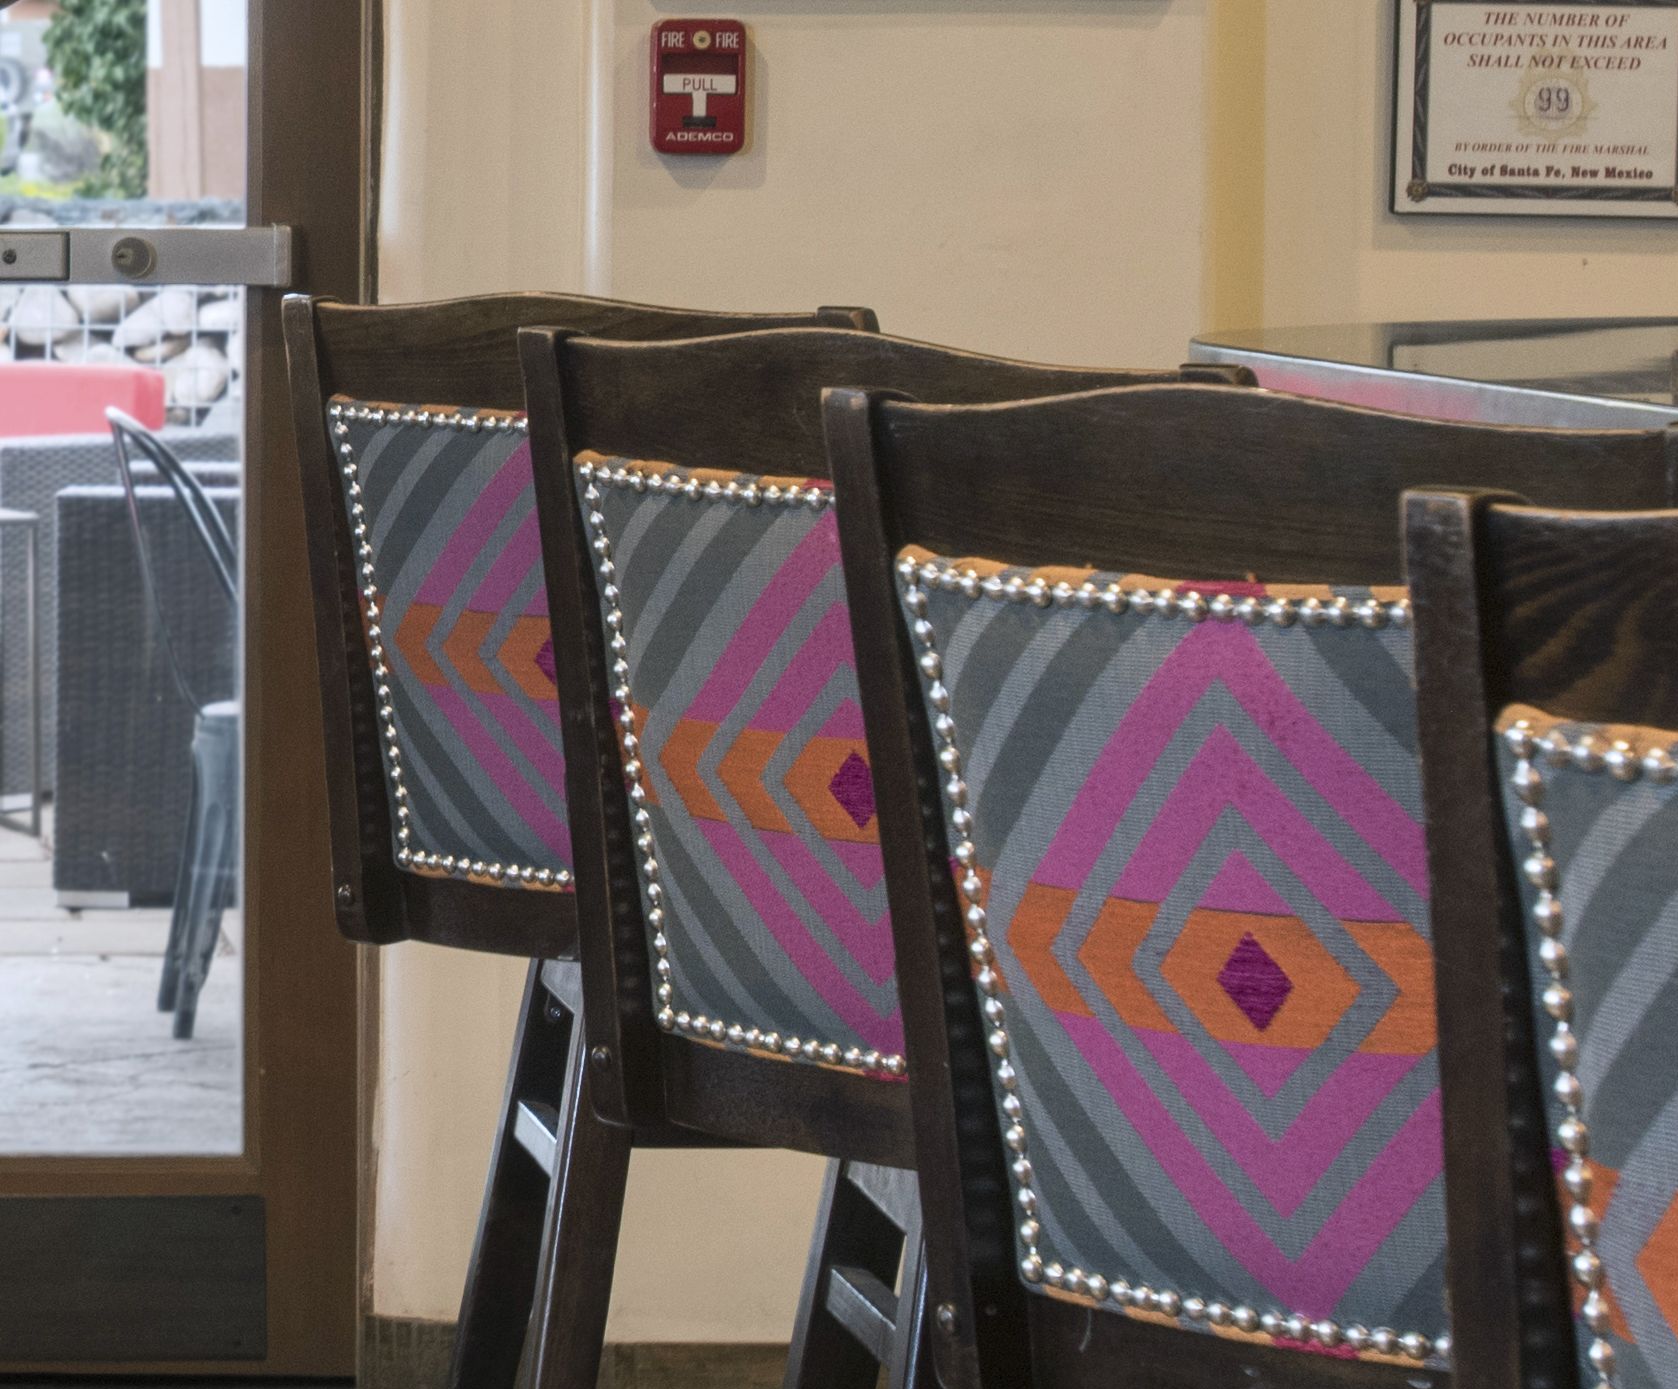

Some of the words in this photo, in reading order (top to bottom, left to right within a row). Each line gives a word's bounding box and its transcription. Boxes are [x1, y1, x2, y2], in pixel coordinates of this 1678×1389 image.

[1483, 12, 1517, 26] THE
[1523, 12, 1600, 27] NUMBER
[1604, 13, 1631, 28] OF
[661, 31, 685, 48] FIRE
[715, 31, 740, 49] FIRE
[1443, 32, 1547, 48] OCCUPANTS
[1552, 34, 1572, 48] IN
[1576, 35, 1617, 48] THIS
[1621, 37, 1667, 49] AREA
[1467, 54, 1524, 69] SHALL
[1529, 55, 1566, 70] NOT
[1570, 56, 1642, 71] EXCEED
[682, 77, 718, 92] PULL
[1537, 86, 1571, 112] 99
[665, 131, 734, 142] ADEMCO
[1454, 142, 1471, 153] BY
[1471, 142, 1513, 153] ORDER
[1515, 143, 1533, 154] OF
[1534, 143, 1557, 154] THE
[1561, 144, 1590, 155] FIRE
[1593, 144, 1650, 156] MARSHAL
[1447, 164, 1476, 179] City
[1481, 164, 1496, 177] of
[1499, 164, 1540, 178] Santa
[1544, 165, 1566, 179] Fe,
[1570, 166, 1599, 179] New
[1604, 166, 1653, 179] Mexico
